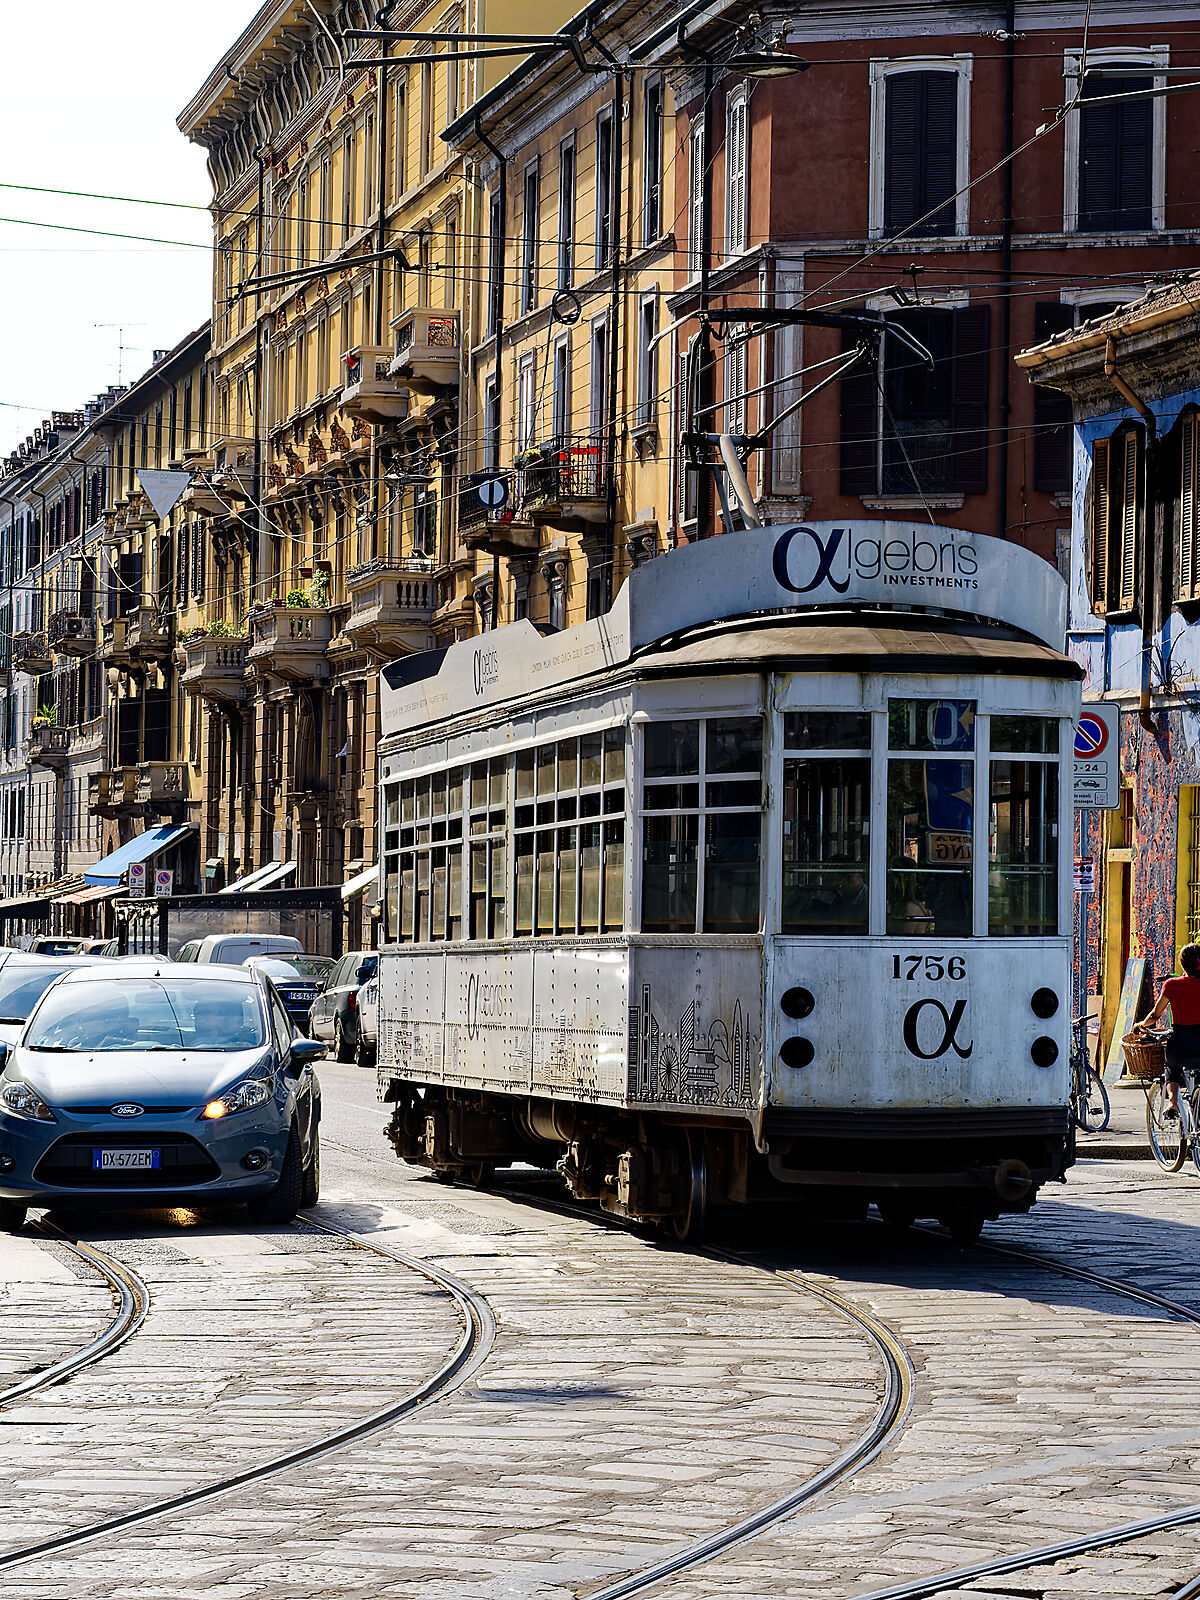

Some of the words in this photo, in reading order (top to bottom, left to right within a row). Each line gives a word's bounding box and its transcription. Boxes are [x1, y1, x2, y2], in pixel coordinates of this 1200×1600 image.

[883, 574, 979, 590] INVESTMENTS
[907, 701, 958, 746] 10
[892, 954, 967, 981] 1756
[117, 1105, 137, 1114] Ford
